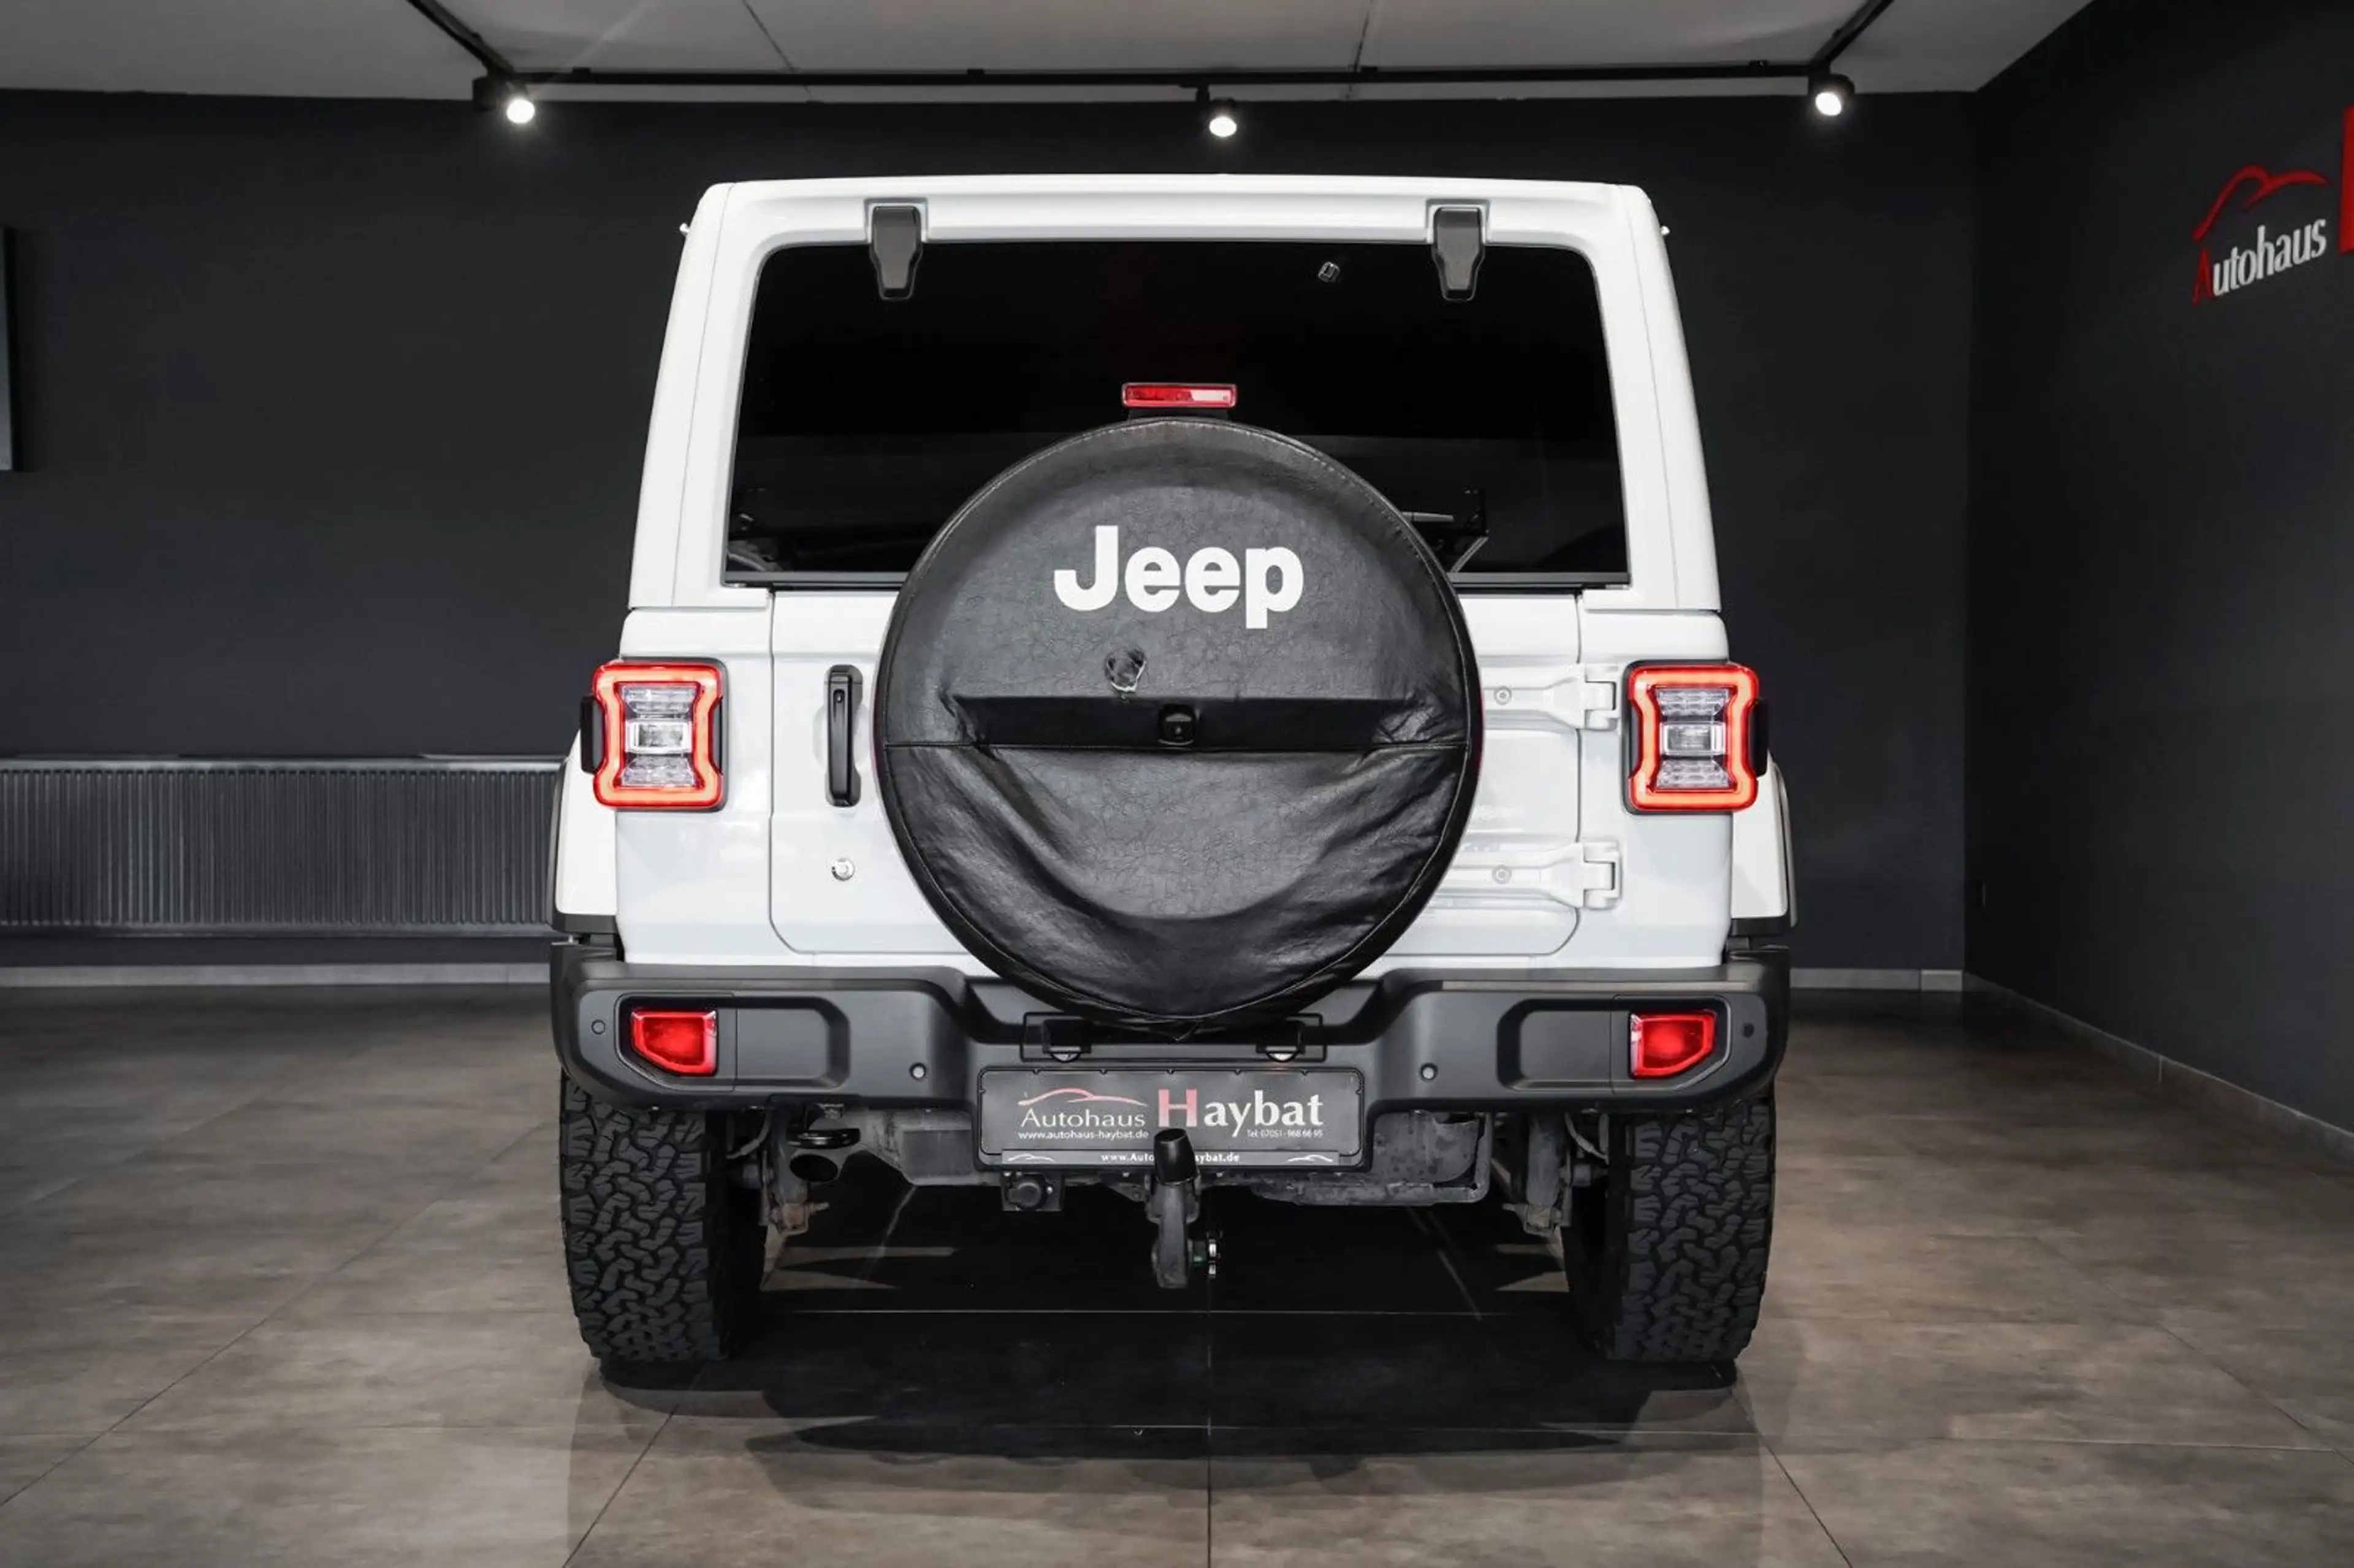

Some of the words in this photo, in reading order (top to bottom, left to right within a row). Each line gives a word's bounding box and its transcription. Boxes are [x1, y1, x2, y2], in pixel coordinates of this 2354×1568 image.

[2192, 218, 2327, 306] Autohaus
[1054, 525, 1304, 629] Jeep
[1018, 1130, 1149, 1141] www.autohaus-haybat.de
[1020, 1108, 1146, 1128] Autohaus
[1158, 1089, 1324, 1138] Haybat
